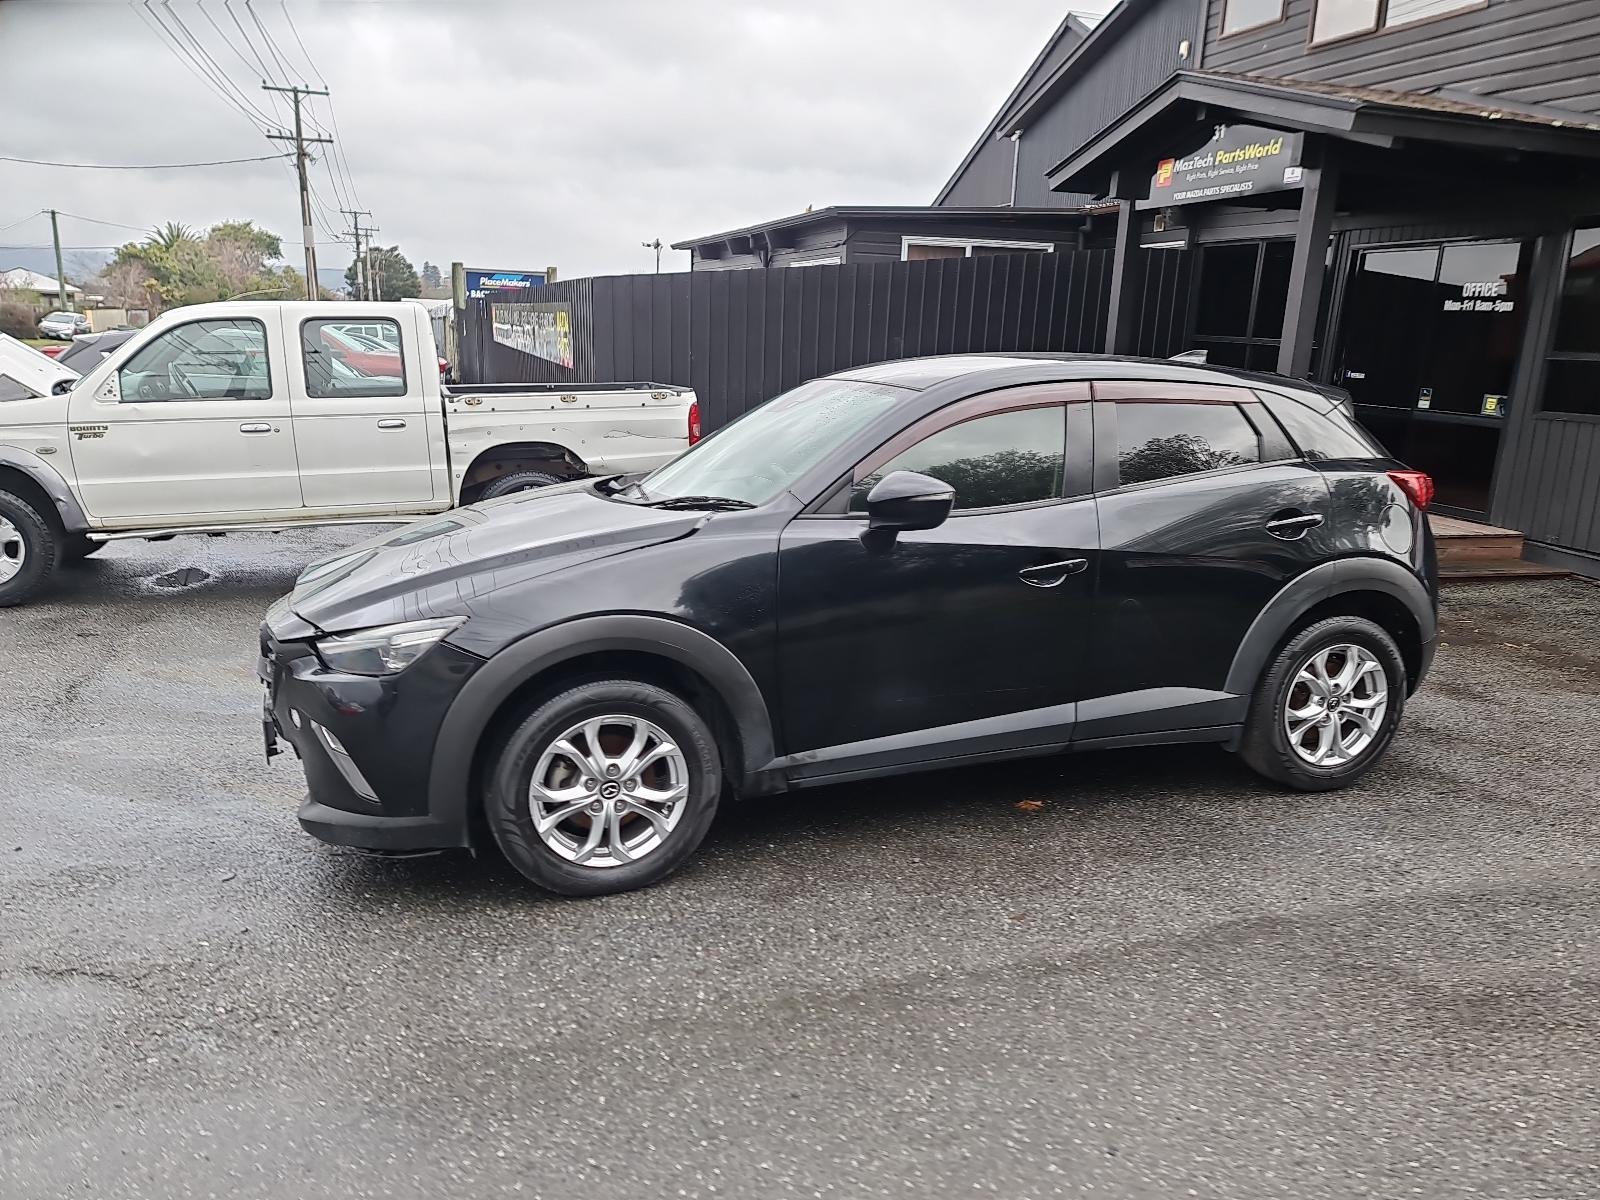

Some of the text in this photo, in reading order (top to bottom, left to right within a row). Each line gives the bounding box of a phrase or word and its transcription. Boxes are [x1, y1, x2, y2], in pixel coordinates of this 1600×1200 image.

[1213, 124, 1226, 140] 31
[1173, 137, 1283, 173] MazTech PartsWorld
[1173, 182, 1253, 202] YOUR MAZDA PARTS SPECIALISTS
[480, 276, 531, 288] PlaceMakers
[1462, 282, 1499, 298] OFFICE
[1443, 300, 1474, 310] Mon-Fri
[74, 431, 106, 441] Turbo
